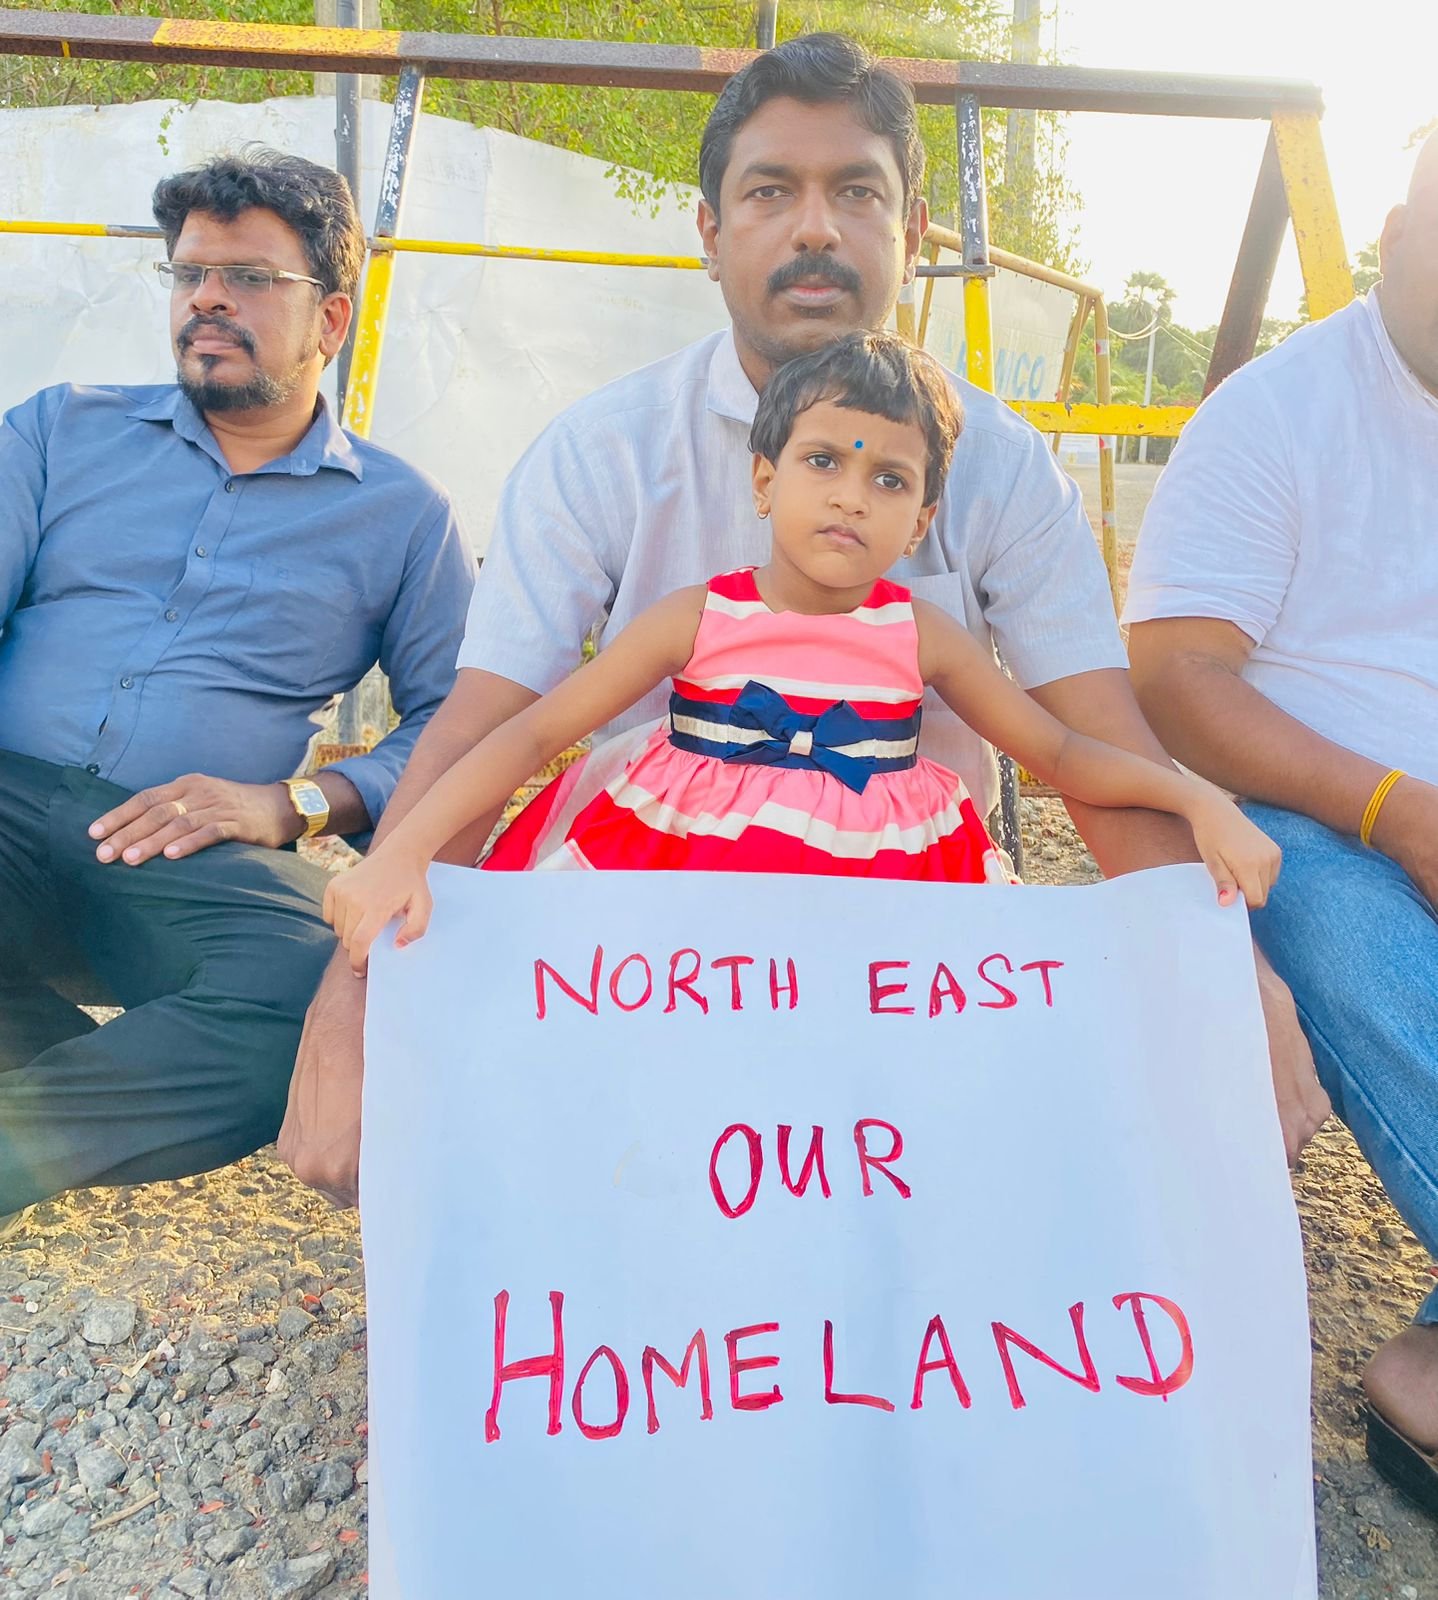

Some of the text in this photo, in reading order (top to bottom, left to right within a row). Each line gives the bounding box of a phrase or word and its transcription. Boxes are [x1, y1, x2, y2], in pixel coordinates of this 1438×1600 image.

[535, 946, 1063, 1020] NORTH EAST
[708, 1118, 911, 1220] OUR
[485, 1290, 1194, 1443] HOMELAND
